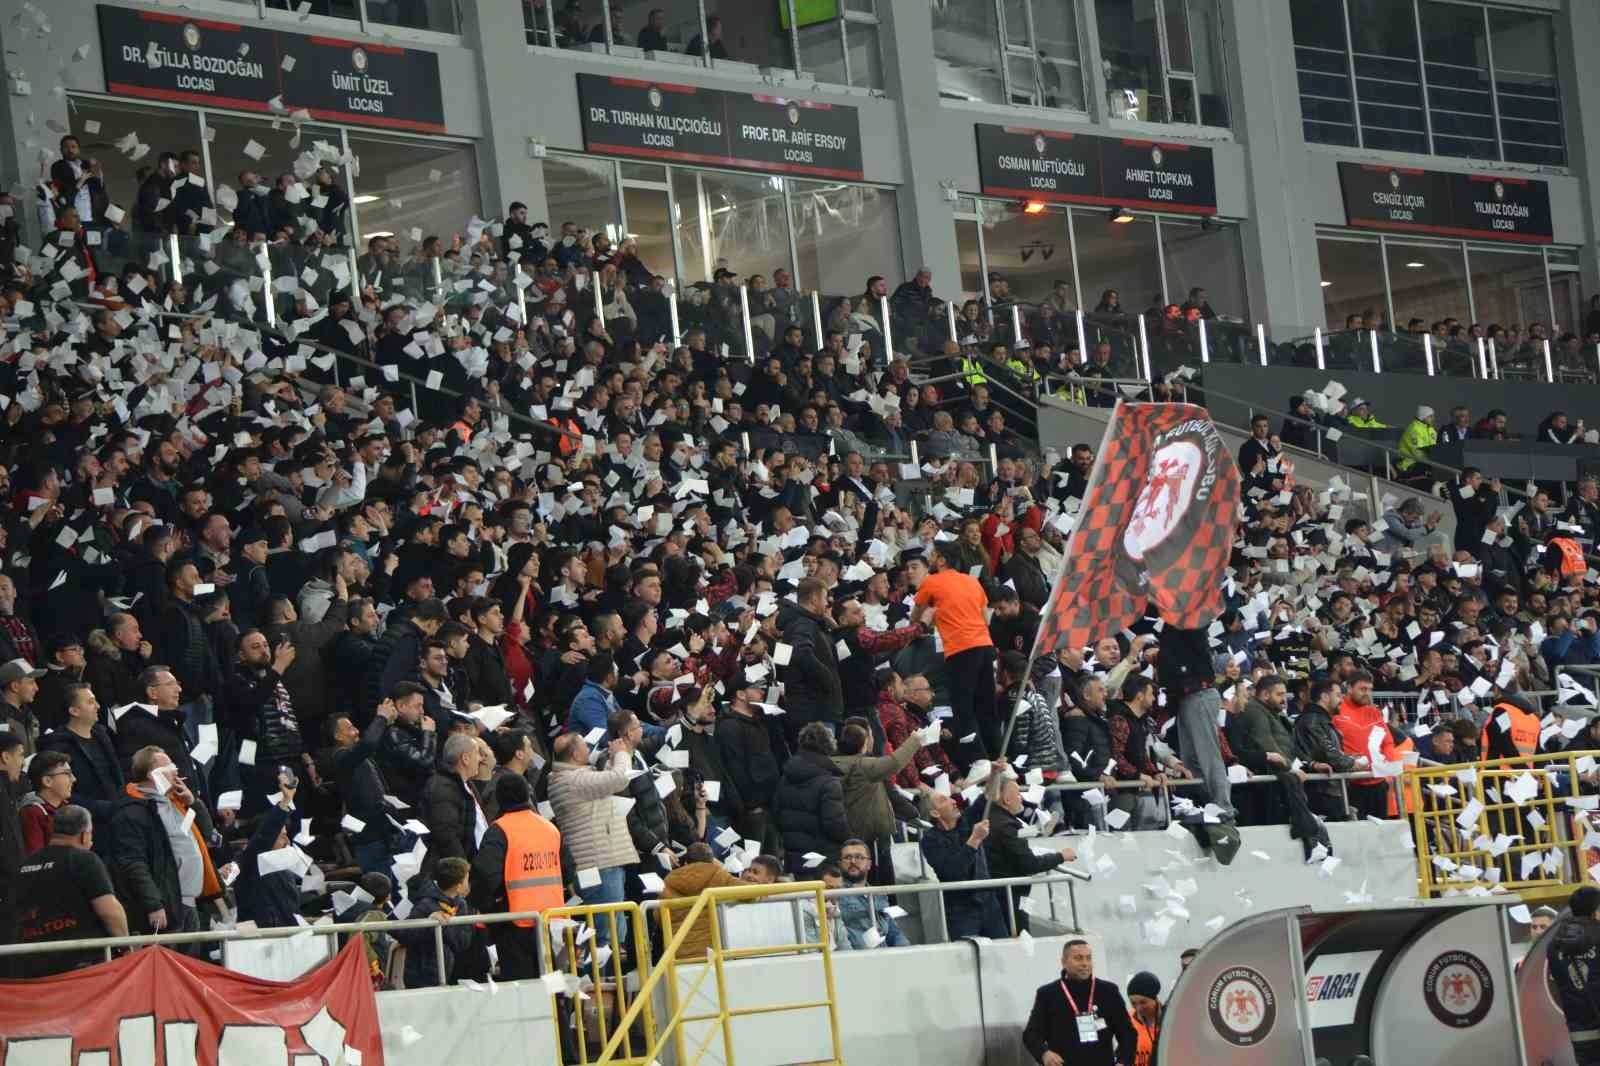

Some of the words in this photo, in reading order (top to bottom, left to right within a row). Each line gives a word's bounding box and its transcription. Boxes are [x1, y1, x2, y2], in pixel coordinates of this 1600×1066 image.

[123, 45, 145, 63] DR.
[192, 54, 264, 79] BOZDOĞAN
[177, 75, 215, 92] LOCASI
[331, 70, 361, 91] ÜMİT
[362, 74, 393, 96] ÜZEL
[348, 96, 384, 113] LOCASI
[590, 107, 610, 123] DR.
[610, 109, 655, 129] TURHAN
[642, 131, 675, 147] LOCASI
[742, 124, 770, 142] PROF.
[771, 128, 790, 143] DR.
[791, 128, 814, 146] ARİF
[814, 133, 847, 152] ERSOY
[784, 148, 814, 163] LOCASI
[998, 155, 1031, 172] OSMAN
[1030, 175, 1057, 189] LOCASI
[1126, 167, 1154, 183] AHMET
[1155, 170, 1193, 187] TOPKAYA
[1147, 187, 1173, 201] LOCASI
[1390, 209, 1414, 221] LOCASI
[1473, 201, 1502, 216] YILMAZ
[1502, 202, 1529, 218] DOĞAN
[1491, 218, 1515, 230] LOCASI
[1317, 972, 1361, 1001] ARCA
